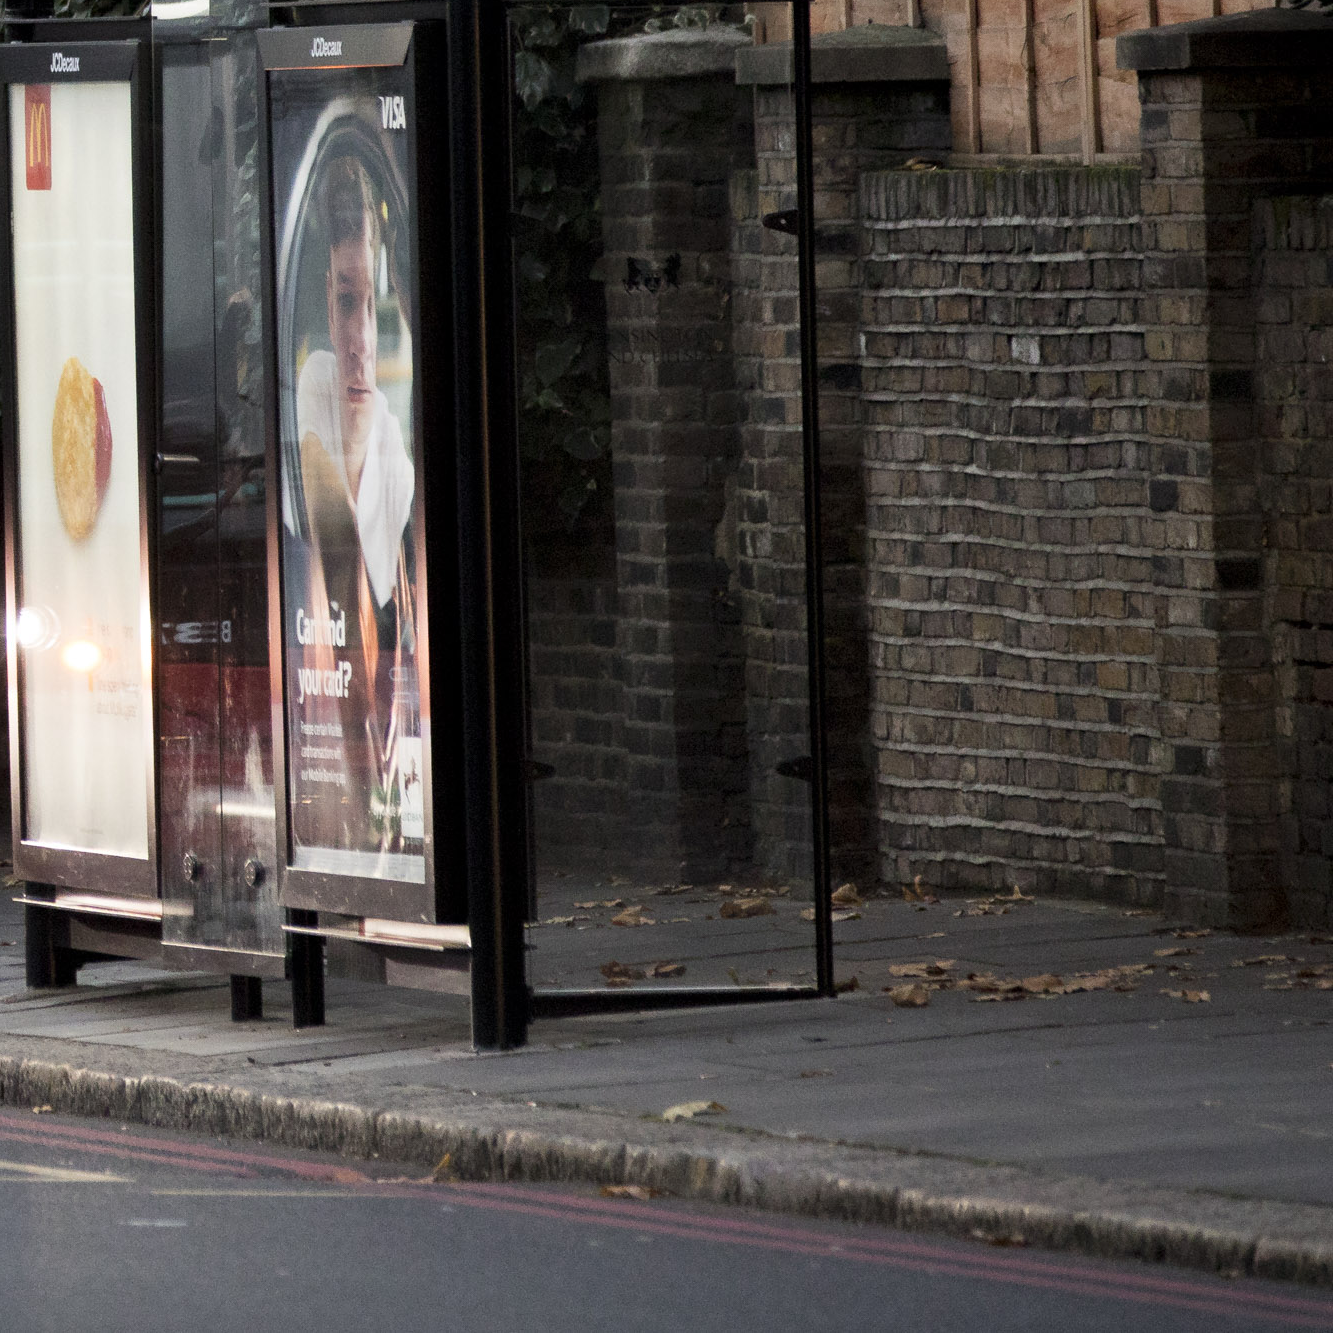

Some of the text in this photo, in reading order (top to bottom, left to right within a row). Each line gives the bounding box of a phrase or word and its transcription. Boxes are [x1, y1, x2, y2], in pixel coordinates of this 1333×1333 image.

[310, 37, 343, 58] JCDecaux
[50, 52, 80, 73] JCDecaux
[378, 95, 407, 130] VISA
